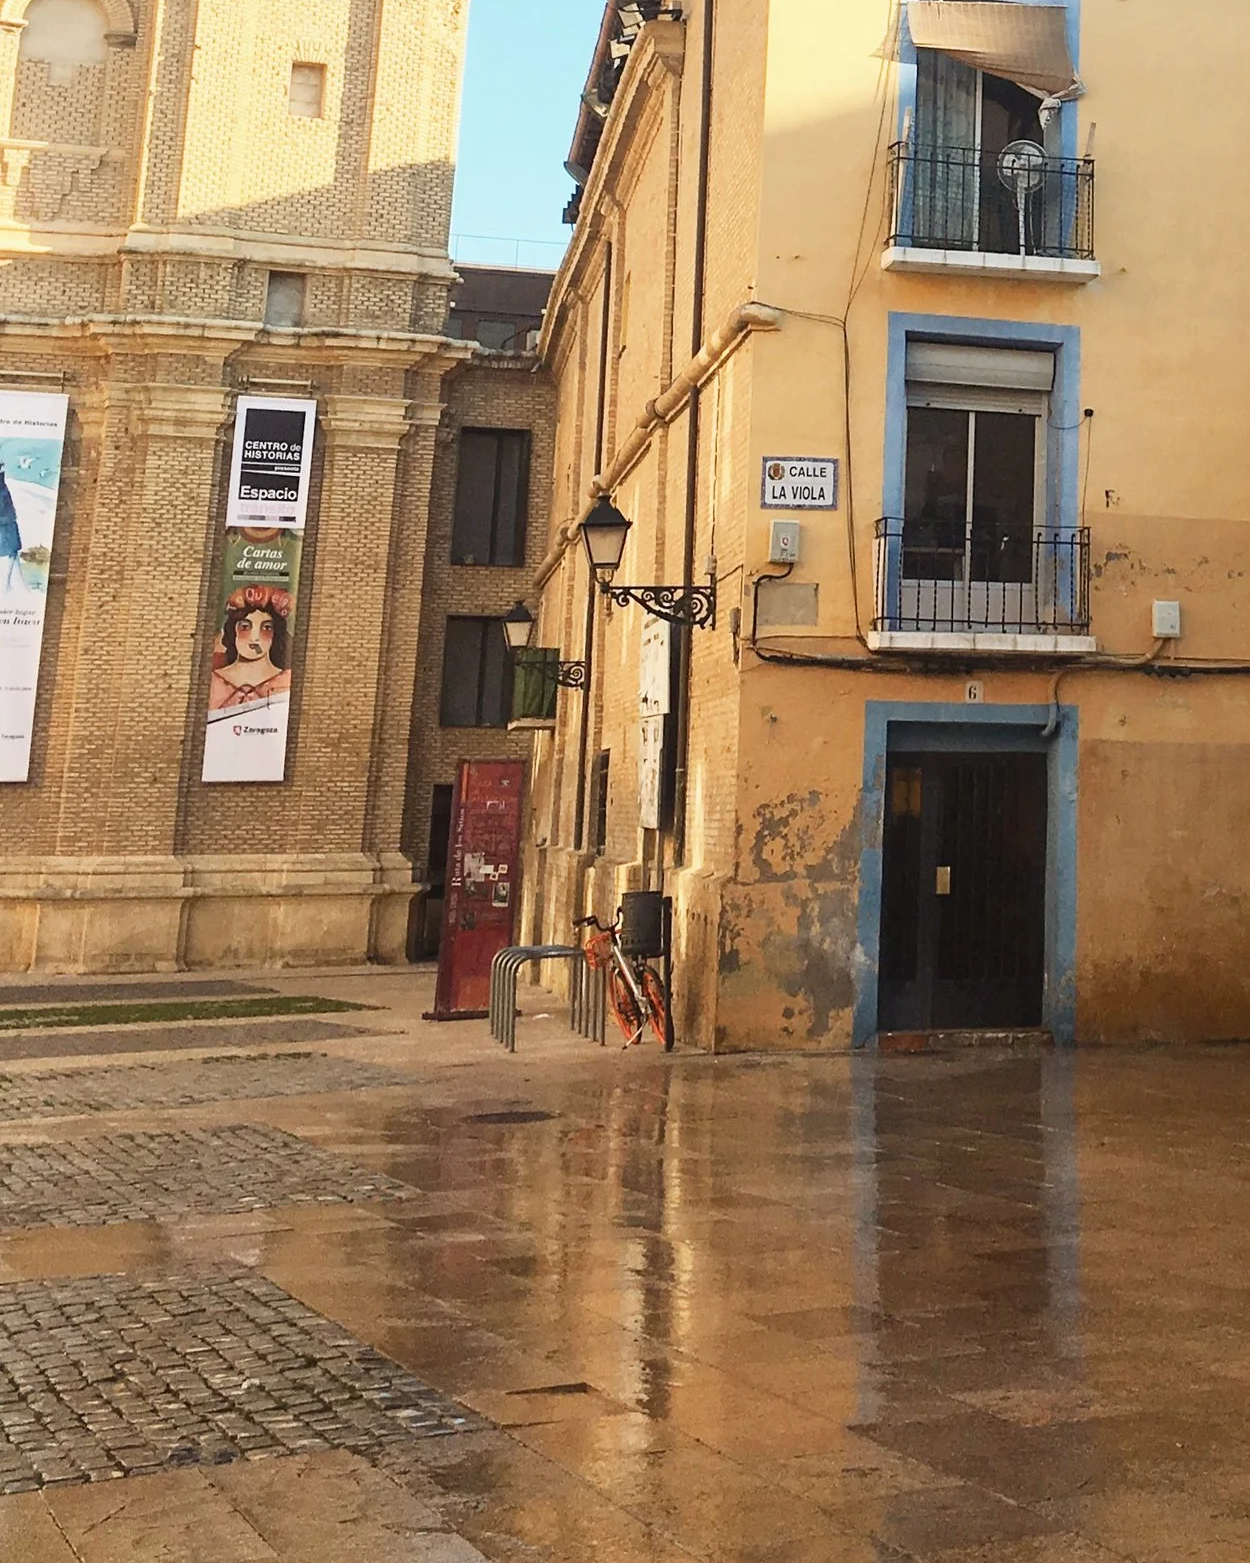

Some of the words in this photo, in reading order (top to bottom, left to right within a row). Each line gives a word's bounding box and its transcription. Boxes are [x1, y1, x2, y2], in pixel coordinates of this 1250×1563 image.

[245, 441, 288, 452] CENTRO
[290, 444, 301, 452] de
[244, 450, 300, 461] HISTORIAS
[789, 466, 827, 478] CALLE
[240, 485, 297, 501] Espacio
[772, 486, 786, 500] LA
[791, 486, 826, 501] VIOLA
[243, 546, 284, 559] Cartas
[236, 558, 252, 569] de
[254, 561, 287, 570] amor
[969, 685, 976, 699] 6
[244, 726, 278, 735] Zaragoza
[451, 862, 461, 887] Ruta
